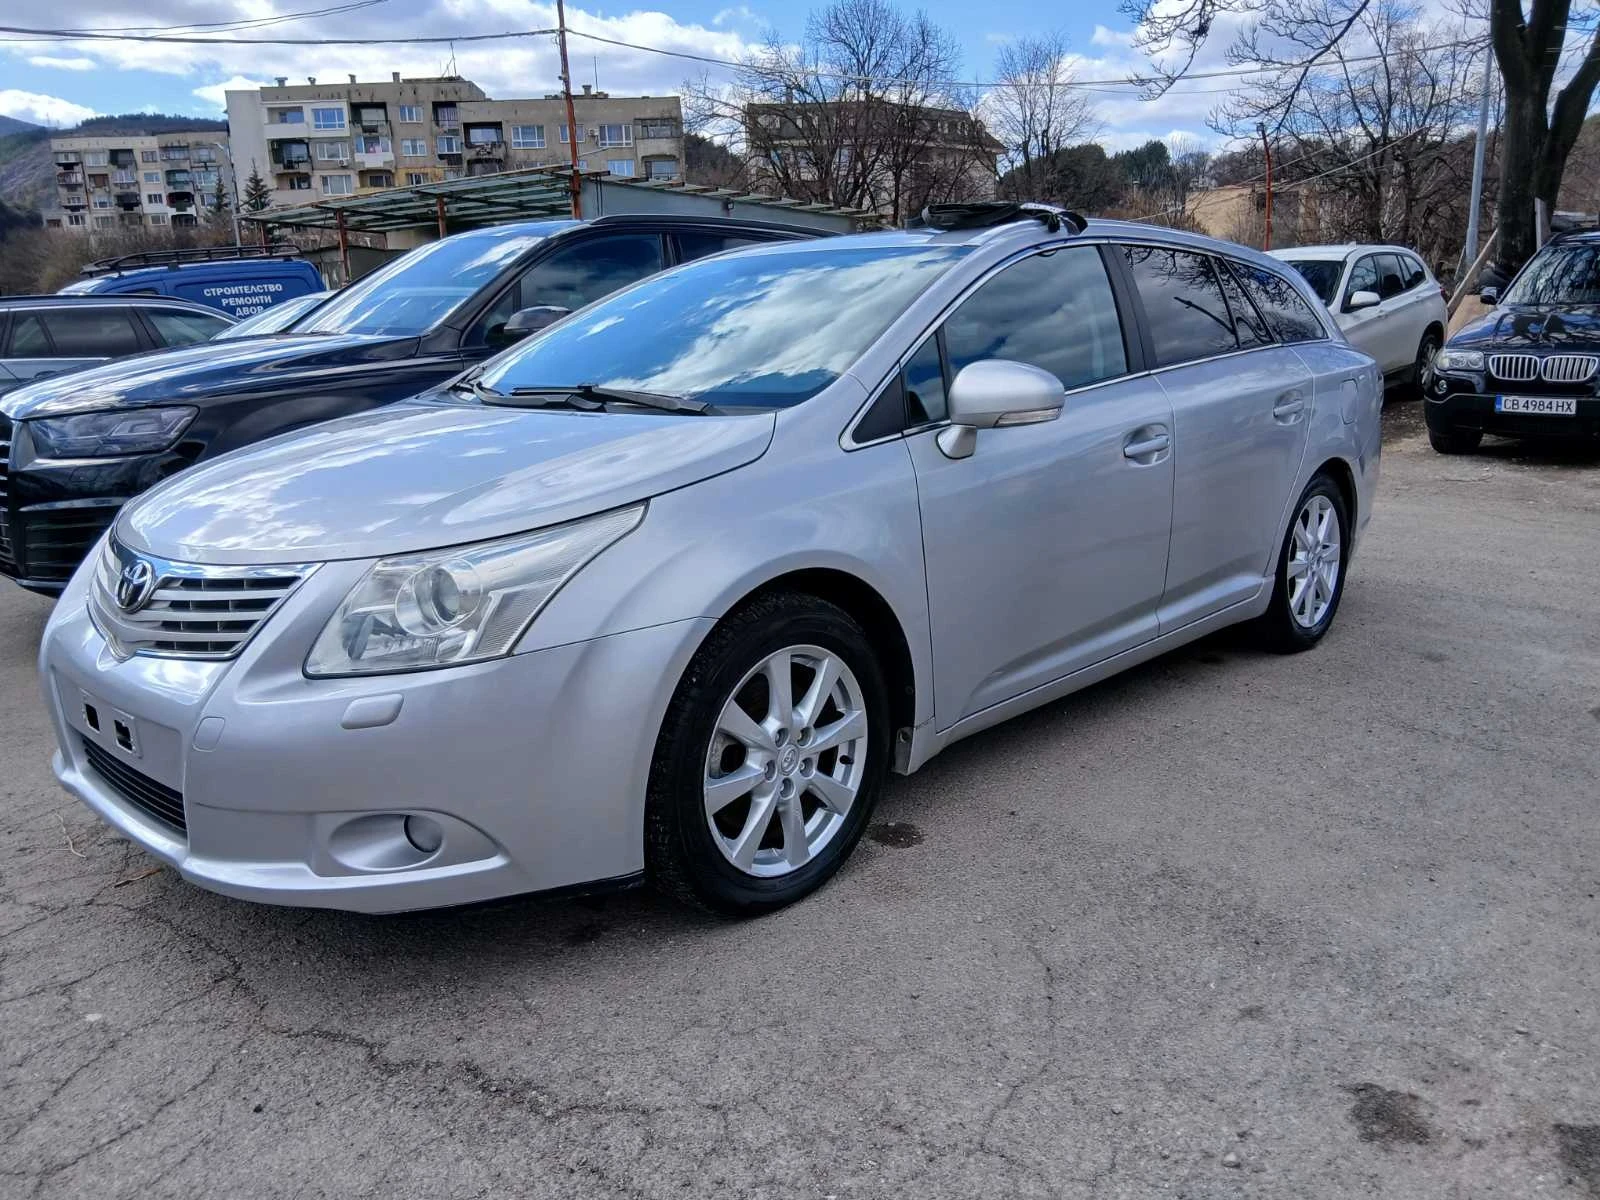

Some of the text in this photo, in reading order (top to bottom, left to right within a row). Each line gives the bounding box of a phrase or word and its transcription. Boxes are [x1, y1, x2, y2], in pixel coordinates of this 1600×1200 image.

[203, 284, 283, 297] СТРОИТЕЛСТВО
[221, 296, 272, 306] РЕМОНТИ
[1522, 400, 1552, 411] 4984
